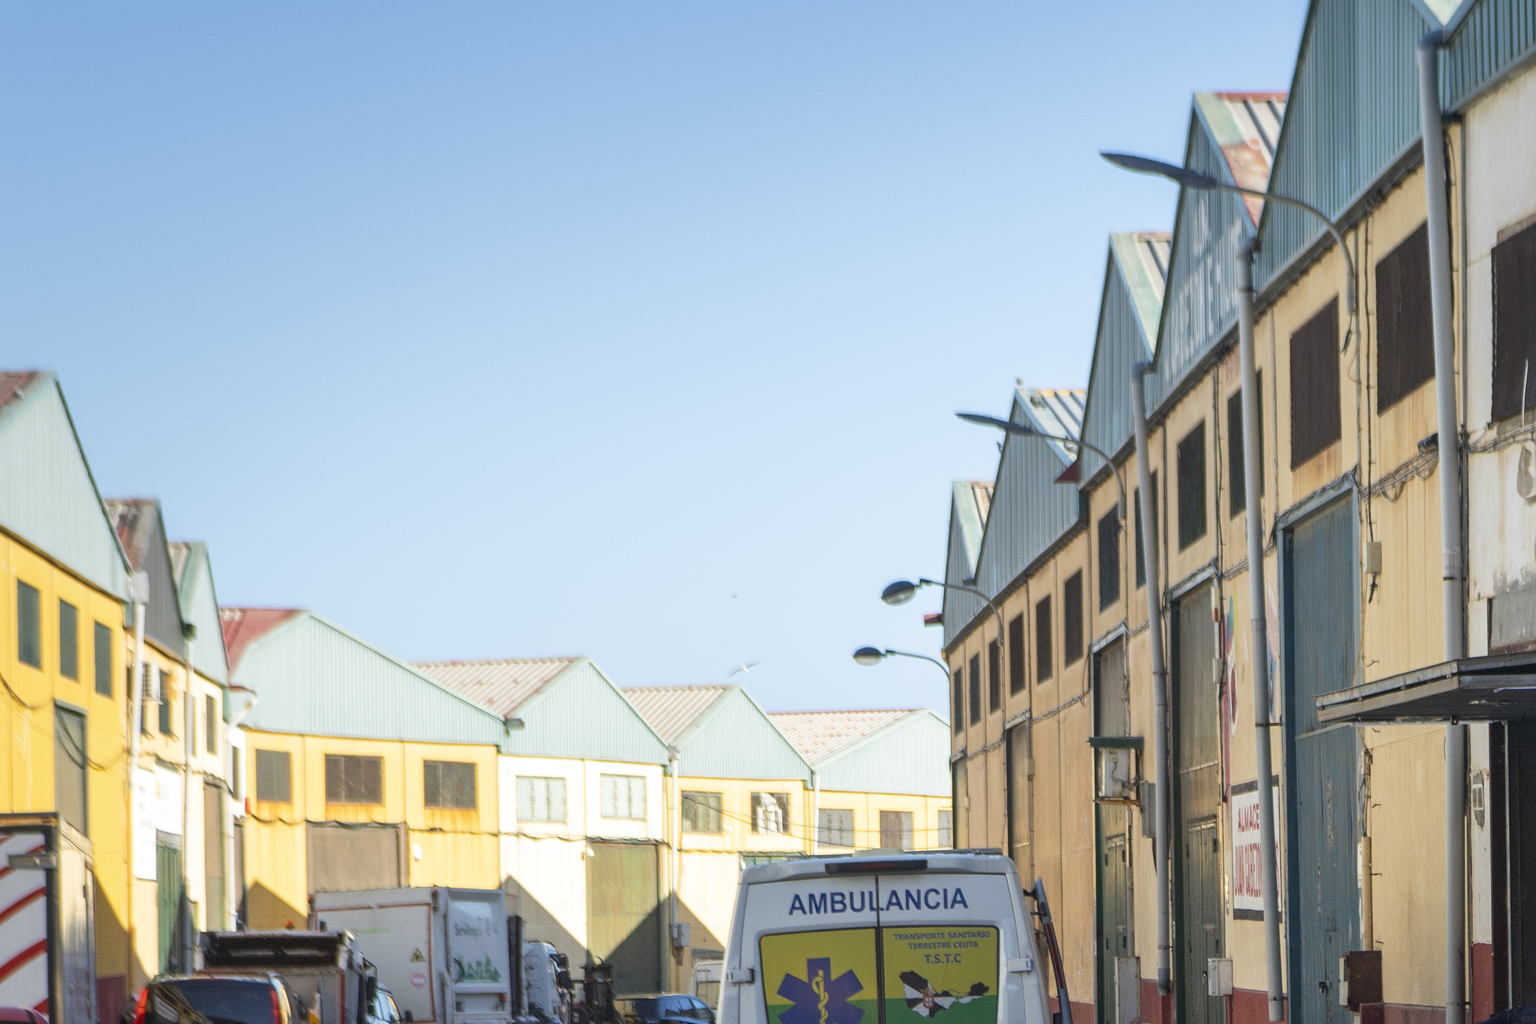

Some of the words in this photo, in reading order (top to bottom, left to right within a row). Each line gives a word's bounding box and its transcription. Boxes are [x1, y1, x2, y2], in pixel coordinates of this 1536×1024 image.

[1238, 804, 1260, 832] ALMACE
[788, 888, 969, 916] AMBULANCIA
[893, 932, 946, 941] TRANSPORTE
[947, 931, 991, 939] SANITARIO
[908, 942, 951, 950] TERRESTRE
[953, 941, 979, 949] CEUTA
